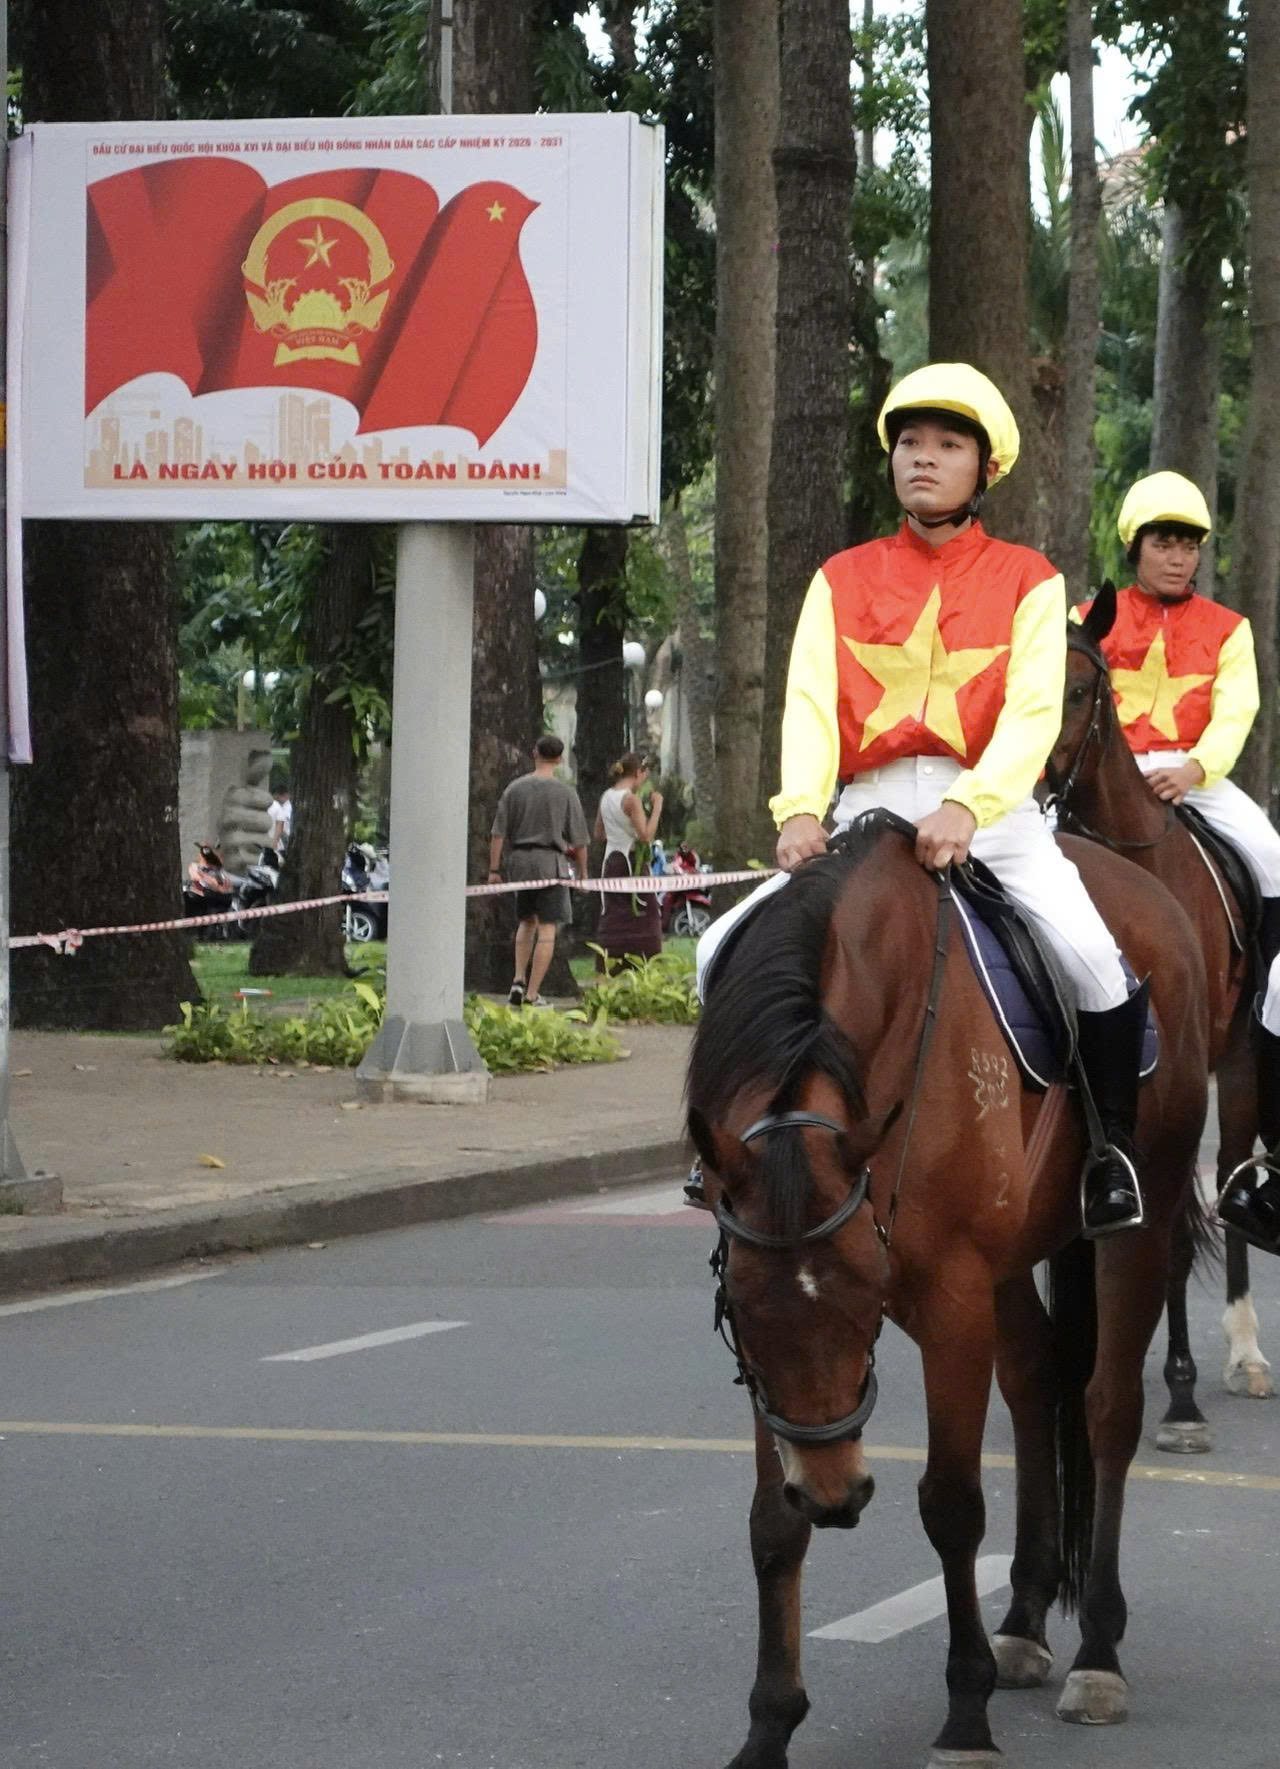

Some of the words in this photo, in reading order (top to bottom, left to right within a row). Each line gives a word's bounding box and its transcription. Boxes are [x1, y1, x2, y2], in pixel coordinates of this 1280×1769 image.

[198, 142, 213, 154] HỘI
[243, 142, 259, 153] XVI
[262, 140, 273, 152] VÀ
[318, 139, 334, 153] HỘI
[336, 139, 362, 151] ĐỒNG
[365, 139, 391, 151] NHÂN
[394, 138, 413, 150] DÂN
[416, 137, 435, 149] CÁC
[438, 136, 457, 149] CẤP
[460, 137, 490, 150] NHIỆM
[508, 136, 532, 148] 2026
[540, 136, 563, 147] 2031
[113, 459, 148, 480] LÀ
[158, 459, 238, 480] NGÀY
[248, 459, 297, 483] HỘI
[307, 456, 368, 480] CỦA
[377, 459, 457, 480] TOÀN
[467, 459, 541, 480] DÂN!
